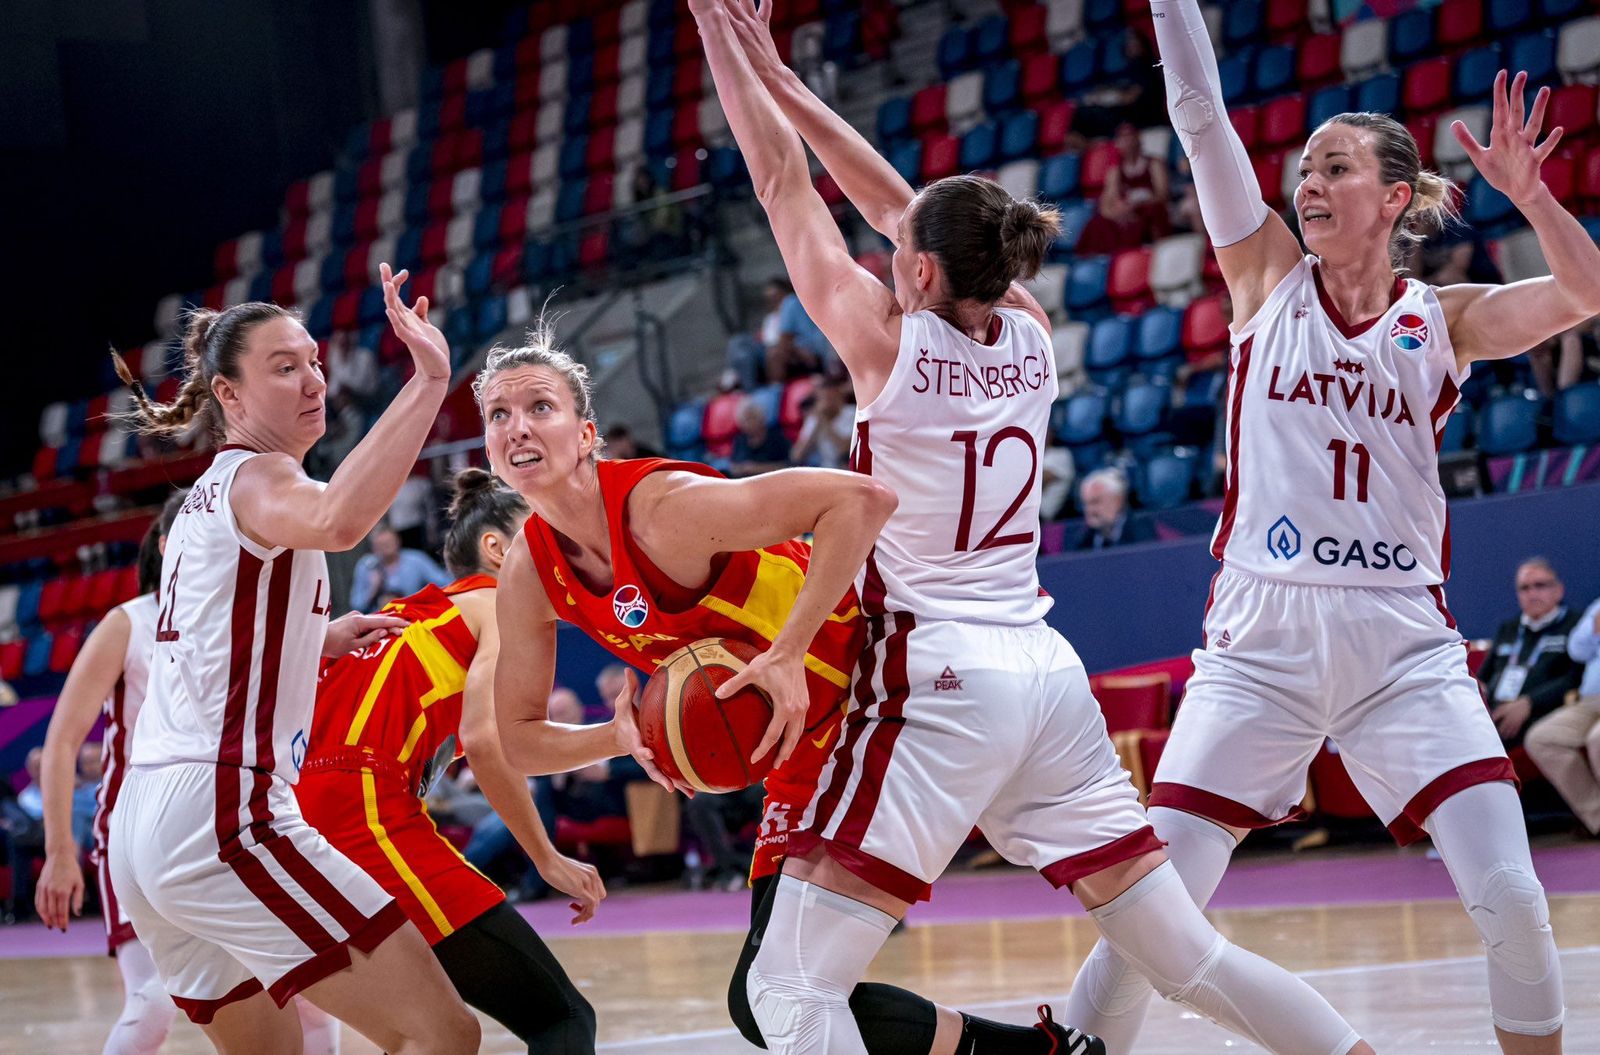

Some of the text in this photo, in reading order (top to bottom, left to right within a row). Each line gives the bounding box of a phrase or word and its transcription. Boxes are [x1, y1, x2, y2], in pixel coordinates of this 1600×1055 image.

[912, 348, 1050, 400] ŠTEINBERGA
[1268, 366, 1415, 426] LATVIJA
[950, 426, 1037, 552] 12
[1327, 438, 1371, 503] 11
[1313, 536, 1417, 571] GASO
[934, 679, 964, 690] PEAK
